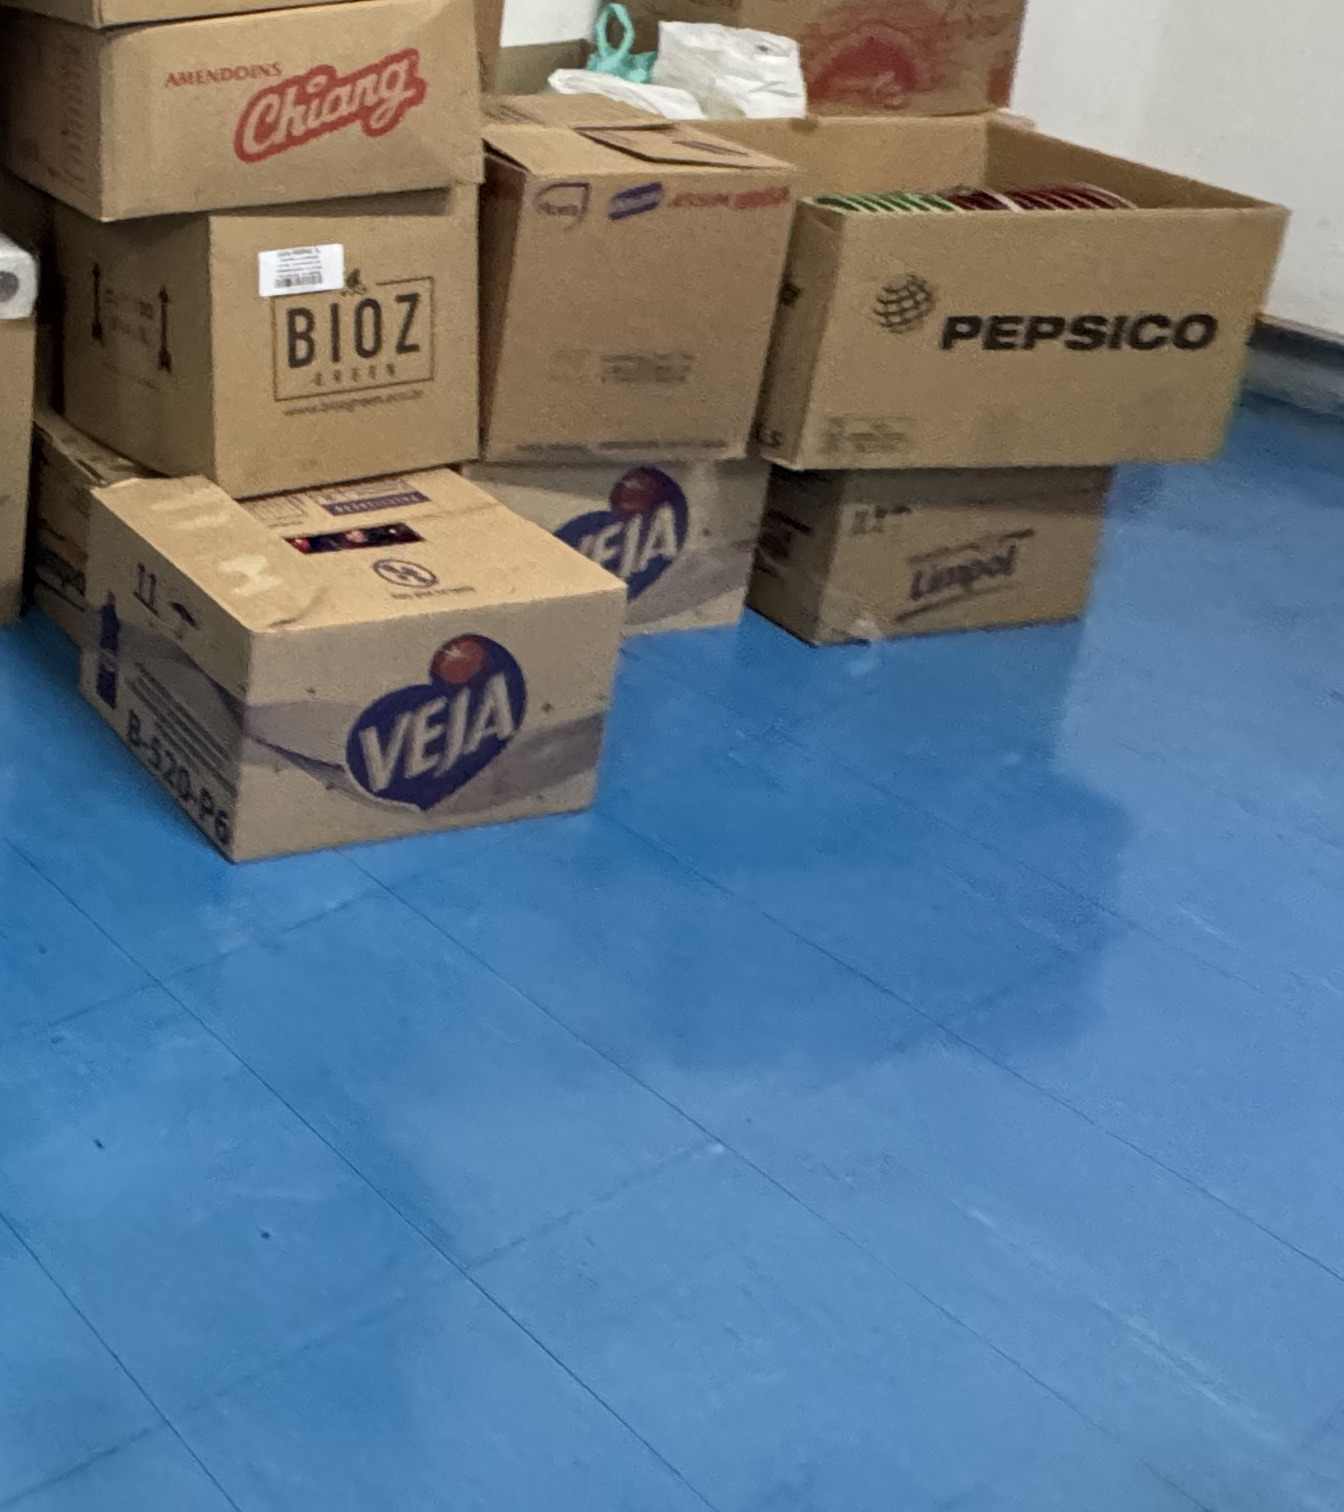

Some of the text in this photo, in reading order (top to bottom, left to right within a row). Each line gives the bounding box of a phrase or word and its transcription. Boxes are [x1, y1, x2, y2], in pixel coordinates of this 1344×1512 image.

[239, 53, 418, 157] Chiang
[287, 292, 421, 369] BIOZ
[939, 313, 1219, 351] PEPSICO
[358, 671, 515, 793] VEJA
